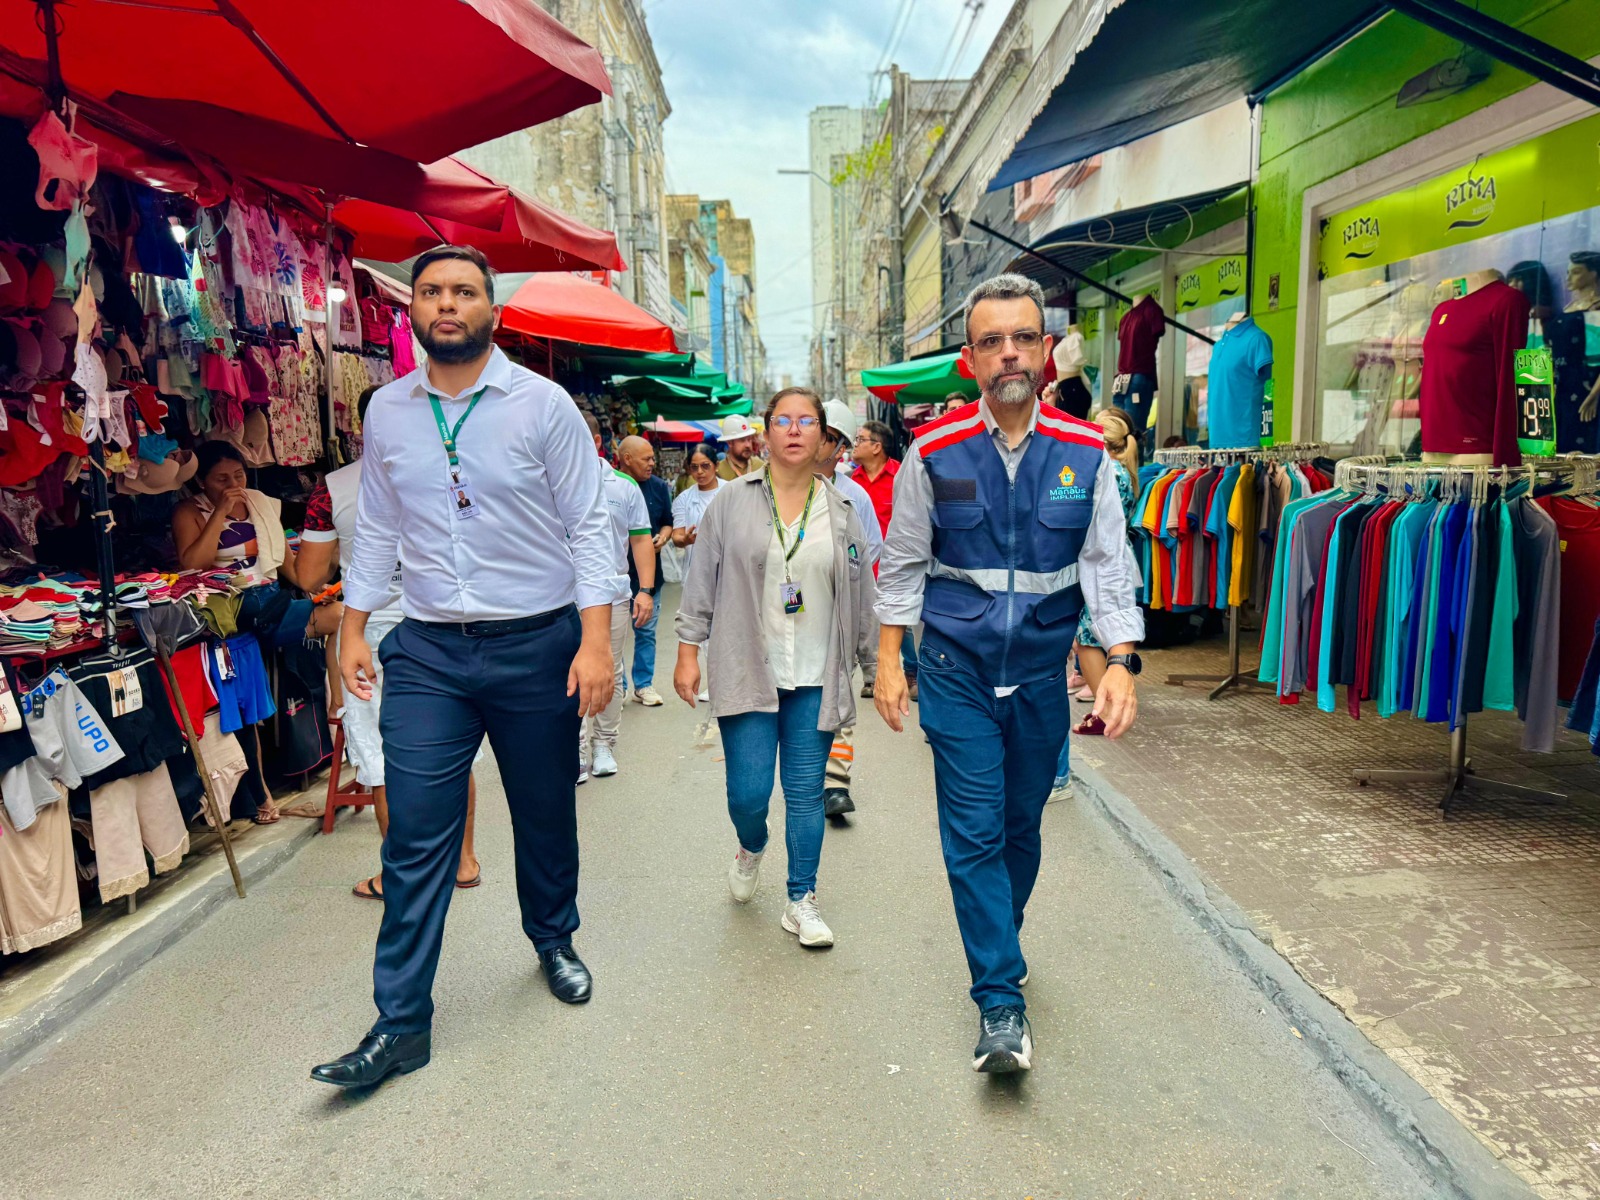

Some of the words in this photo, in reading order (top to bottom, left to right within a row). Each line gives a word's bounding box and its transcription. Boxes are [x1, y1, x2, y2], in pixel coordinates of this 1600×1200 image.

[1446, 175, 1497, 214] RIMA
[1342, 216, 1380, 246] RIMA
[1218, 260, 1241, 283] RIMA
[1181, 274, 1200, 295] RIMA
[1516, 354, 1548, 370] RIMA
[1049, 487, 1087, 496] Manaus
